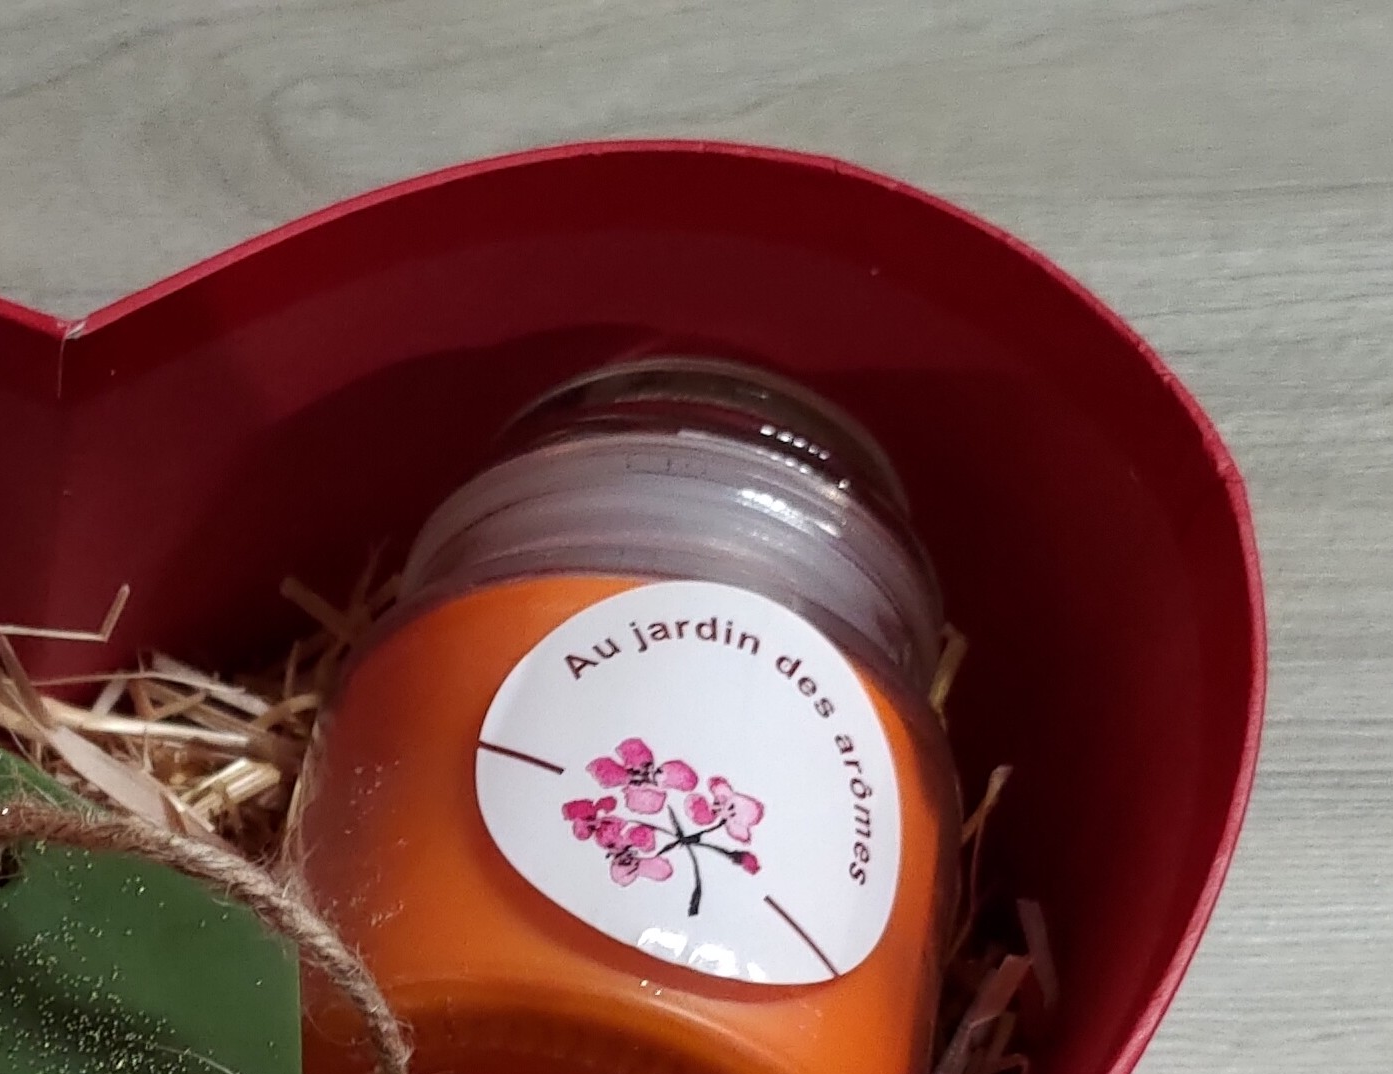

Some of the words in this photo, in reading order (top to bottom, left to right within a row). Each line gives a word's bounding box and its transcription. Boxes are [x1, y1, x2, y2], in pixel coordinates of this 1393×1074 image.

[563, 637, 621, 681] Au
[629, 616, 761, 656] jardin
[775, 654, 836, 719] des
[834, 733, 873, 886] arômes
